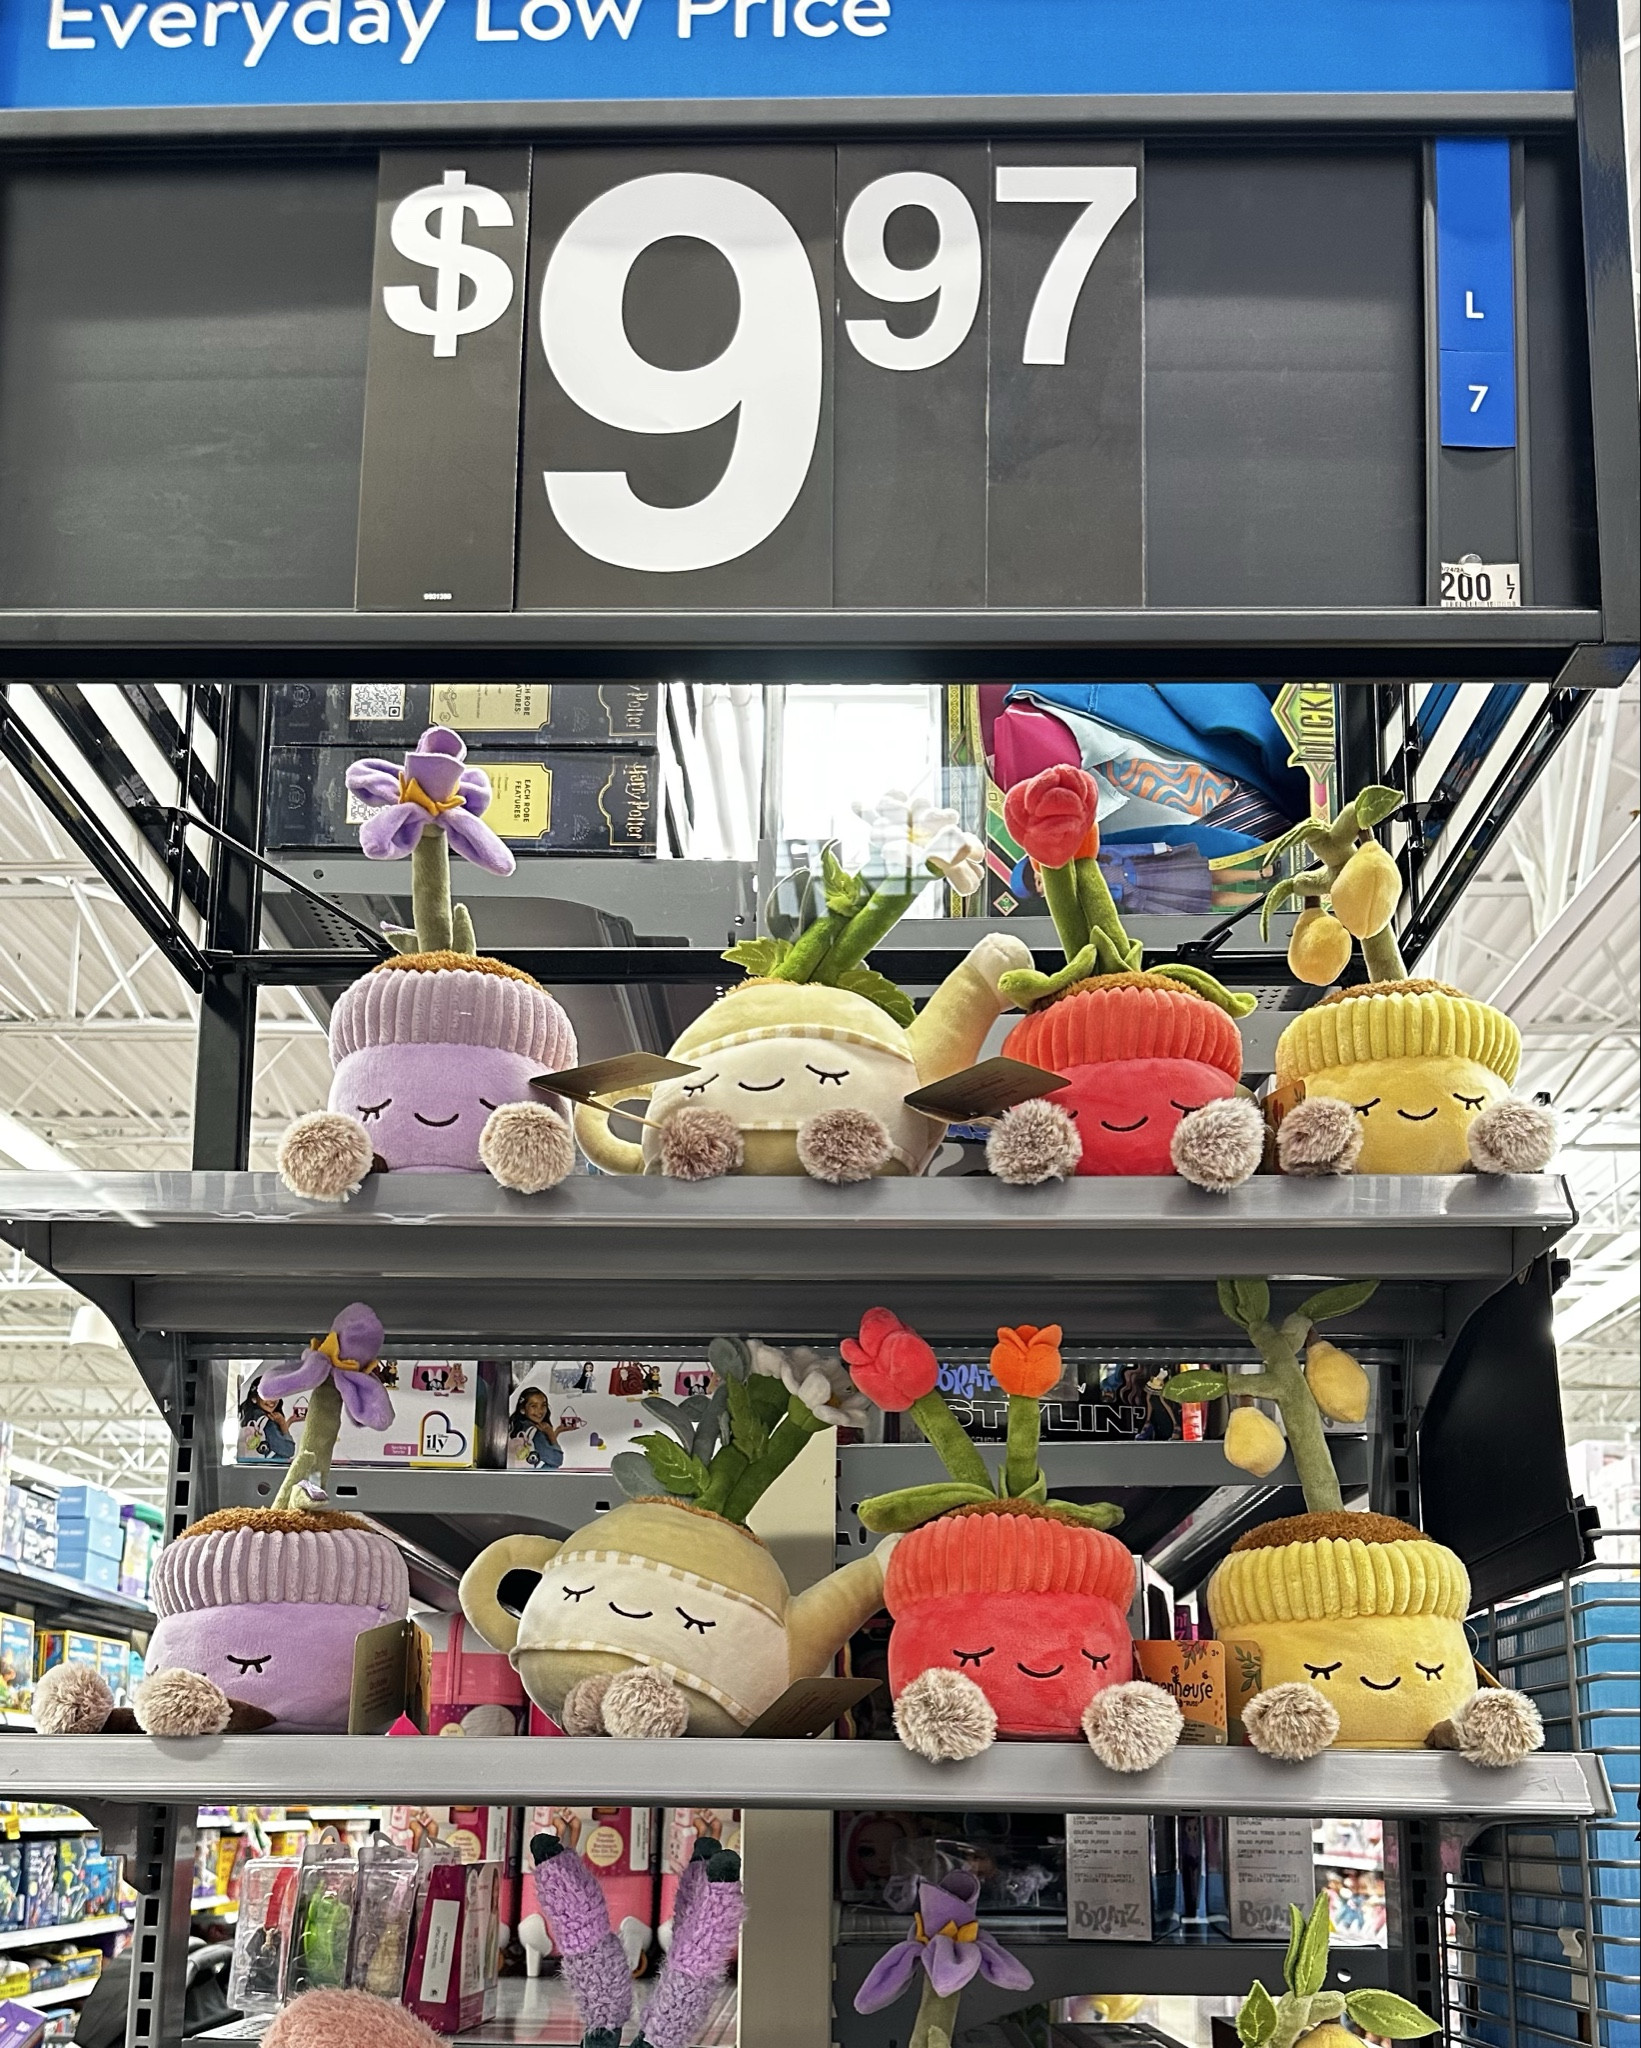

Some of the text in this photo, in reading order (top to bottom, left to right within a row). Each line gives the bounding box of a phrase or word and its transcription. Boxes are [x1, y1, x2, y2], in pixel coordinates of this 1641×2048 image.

[46, 0, 891, 68] Everyday Low Price
[1466, 290, 1485, 319] L
[1468, 384, 1489, 413] 7
[1441, 572, 1492, 602] 200
[1506, 573, 1515, 587] L
[1506, 587, 1515, 600] 7
[523, 695, 531, 716] ROBE
[627, 692, 649, 730] Potter
[522, 779, 532, 823] EACH ROBE
[623, 762, 650, 840] Harry Potter
[426, 1434, 449, 1453] ily
